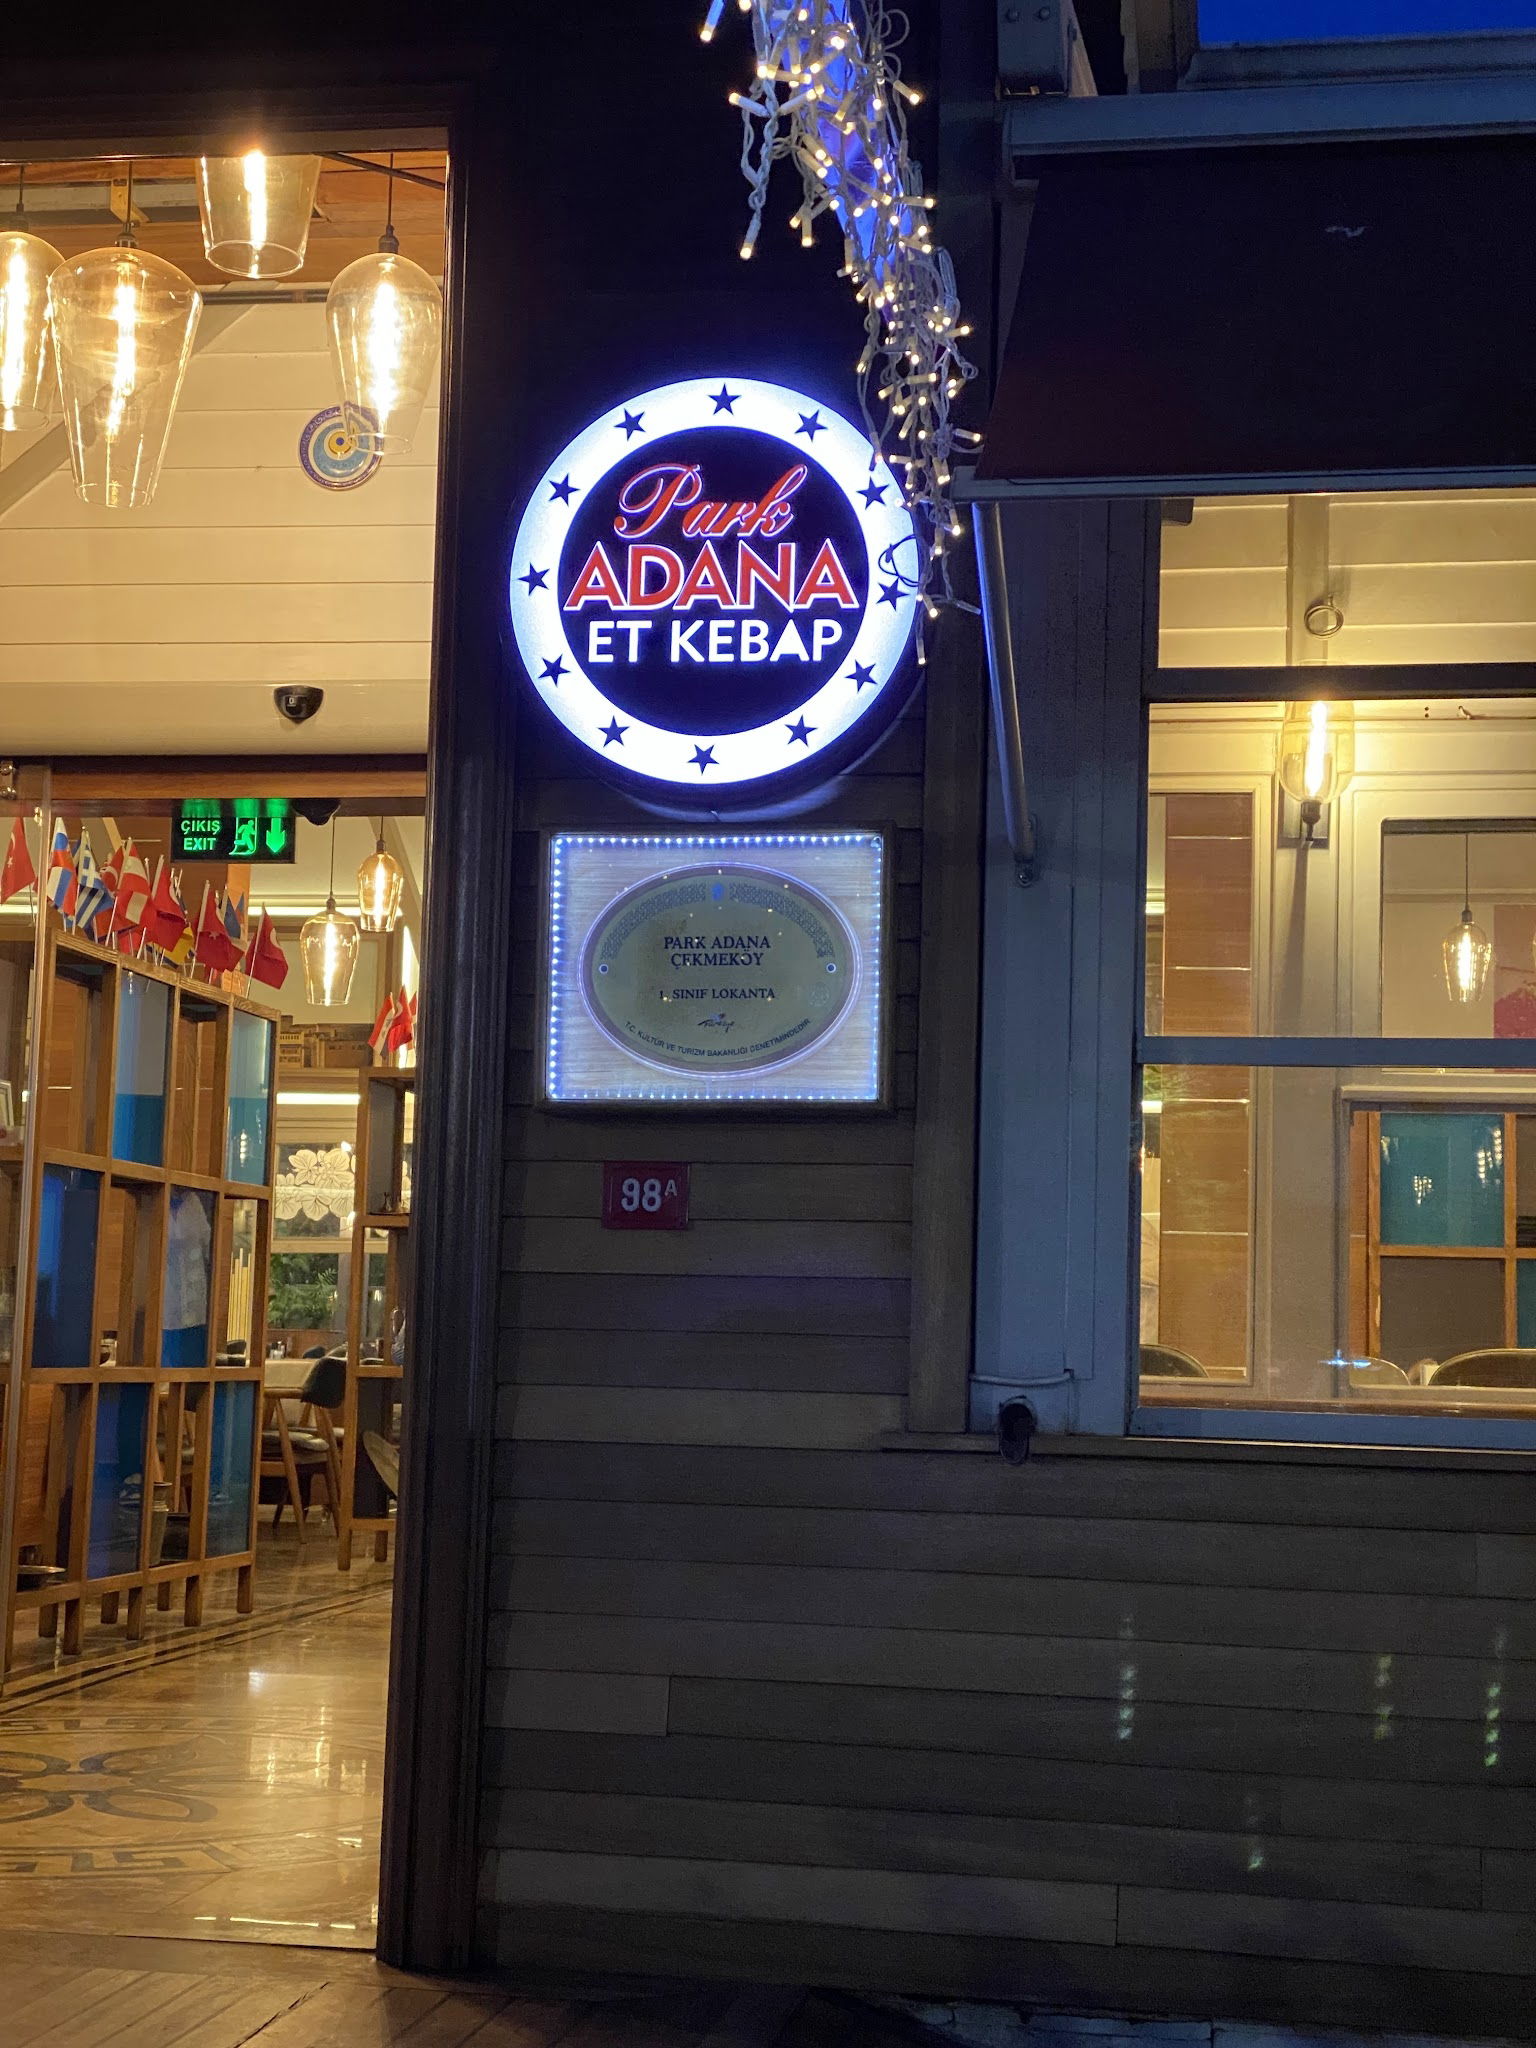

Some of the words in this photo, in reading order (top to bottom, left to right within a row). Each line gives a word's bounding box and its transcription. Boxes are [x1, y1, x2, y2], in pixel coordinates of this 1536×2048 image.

[613, 463, 808, 539] Park
[563, 538, 860, 613] ADANA
[588, 619, 653, 664] ET
[670, 618, 844, 664] KEBAP
[181, 819, 221, 835] ÇIKIŞ
[183, 837, 217, 851] EXIT
[664, 936, 706, 949] PARK
[711, 935, 772, 949] ADANA
[671, 948, 765, 970] ÇEKMEKÖY
[672, 988, 709, 999] SINIF
[712, 987, 776, 999] LOKANTA
